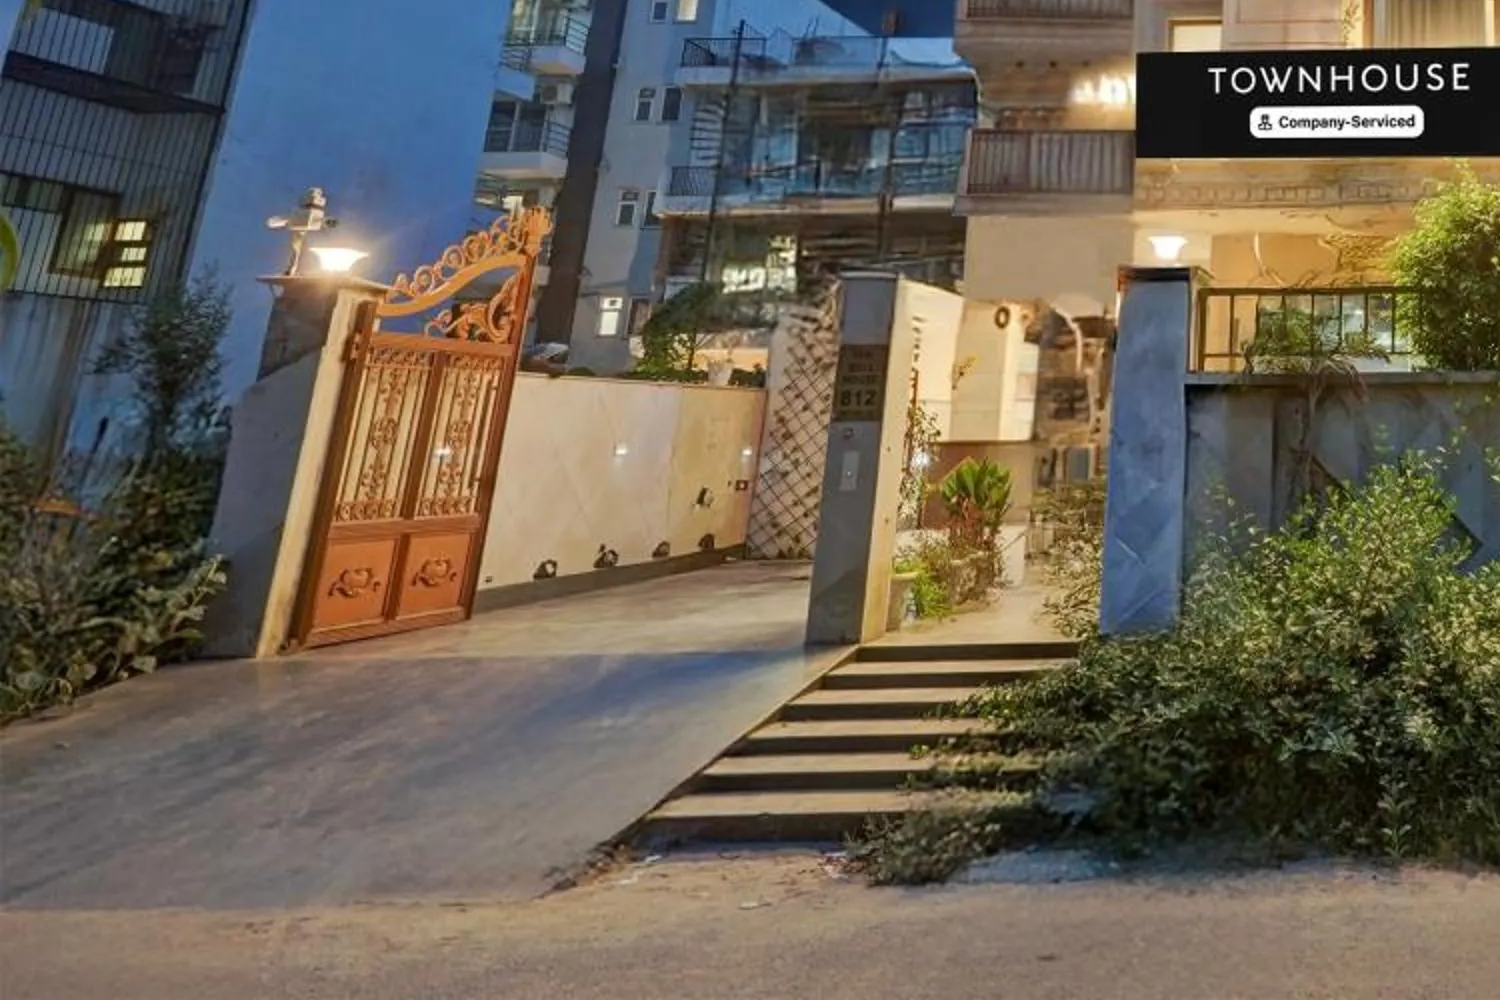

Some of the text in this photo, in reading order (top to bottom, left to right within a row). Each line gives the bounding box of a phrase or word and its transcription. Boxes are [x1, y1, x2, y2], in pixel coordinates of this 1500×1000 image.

[1208, 64, 1470, 94] TOWNHOUSE
[1278, 114, 1416, 131] Company-Serviced
[840, 389, 877, 407] 812
